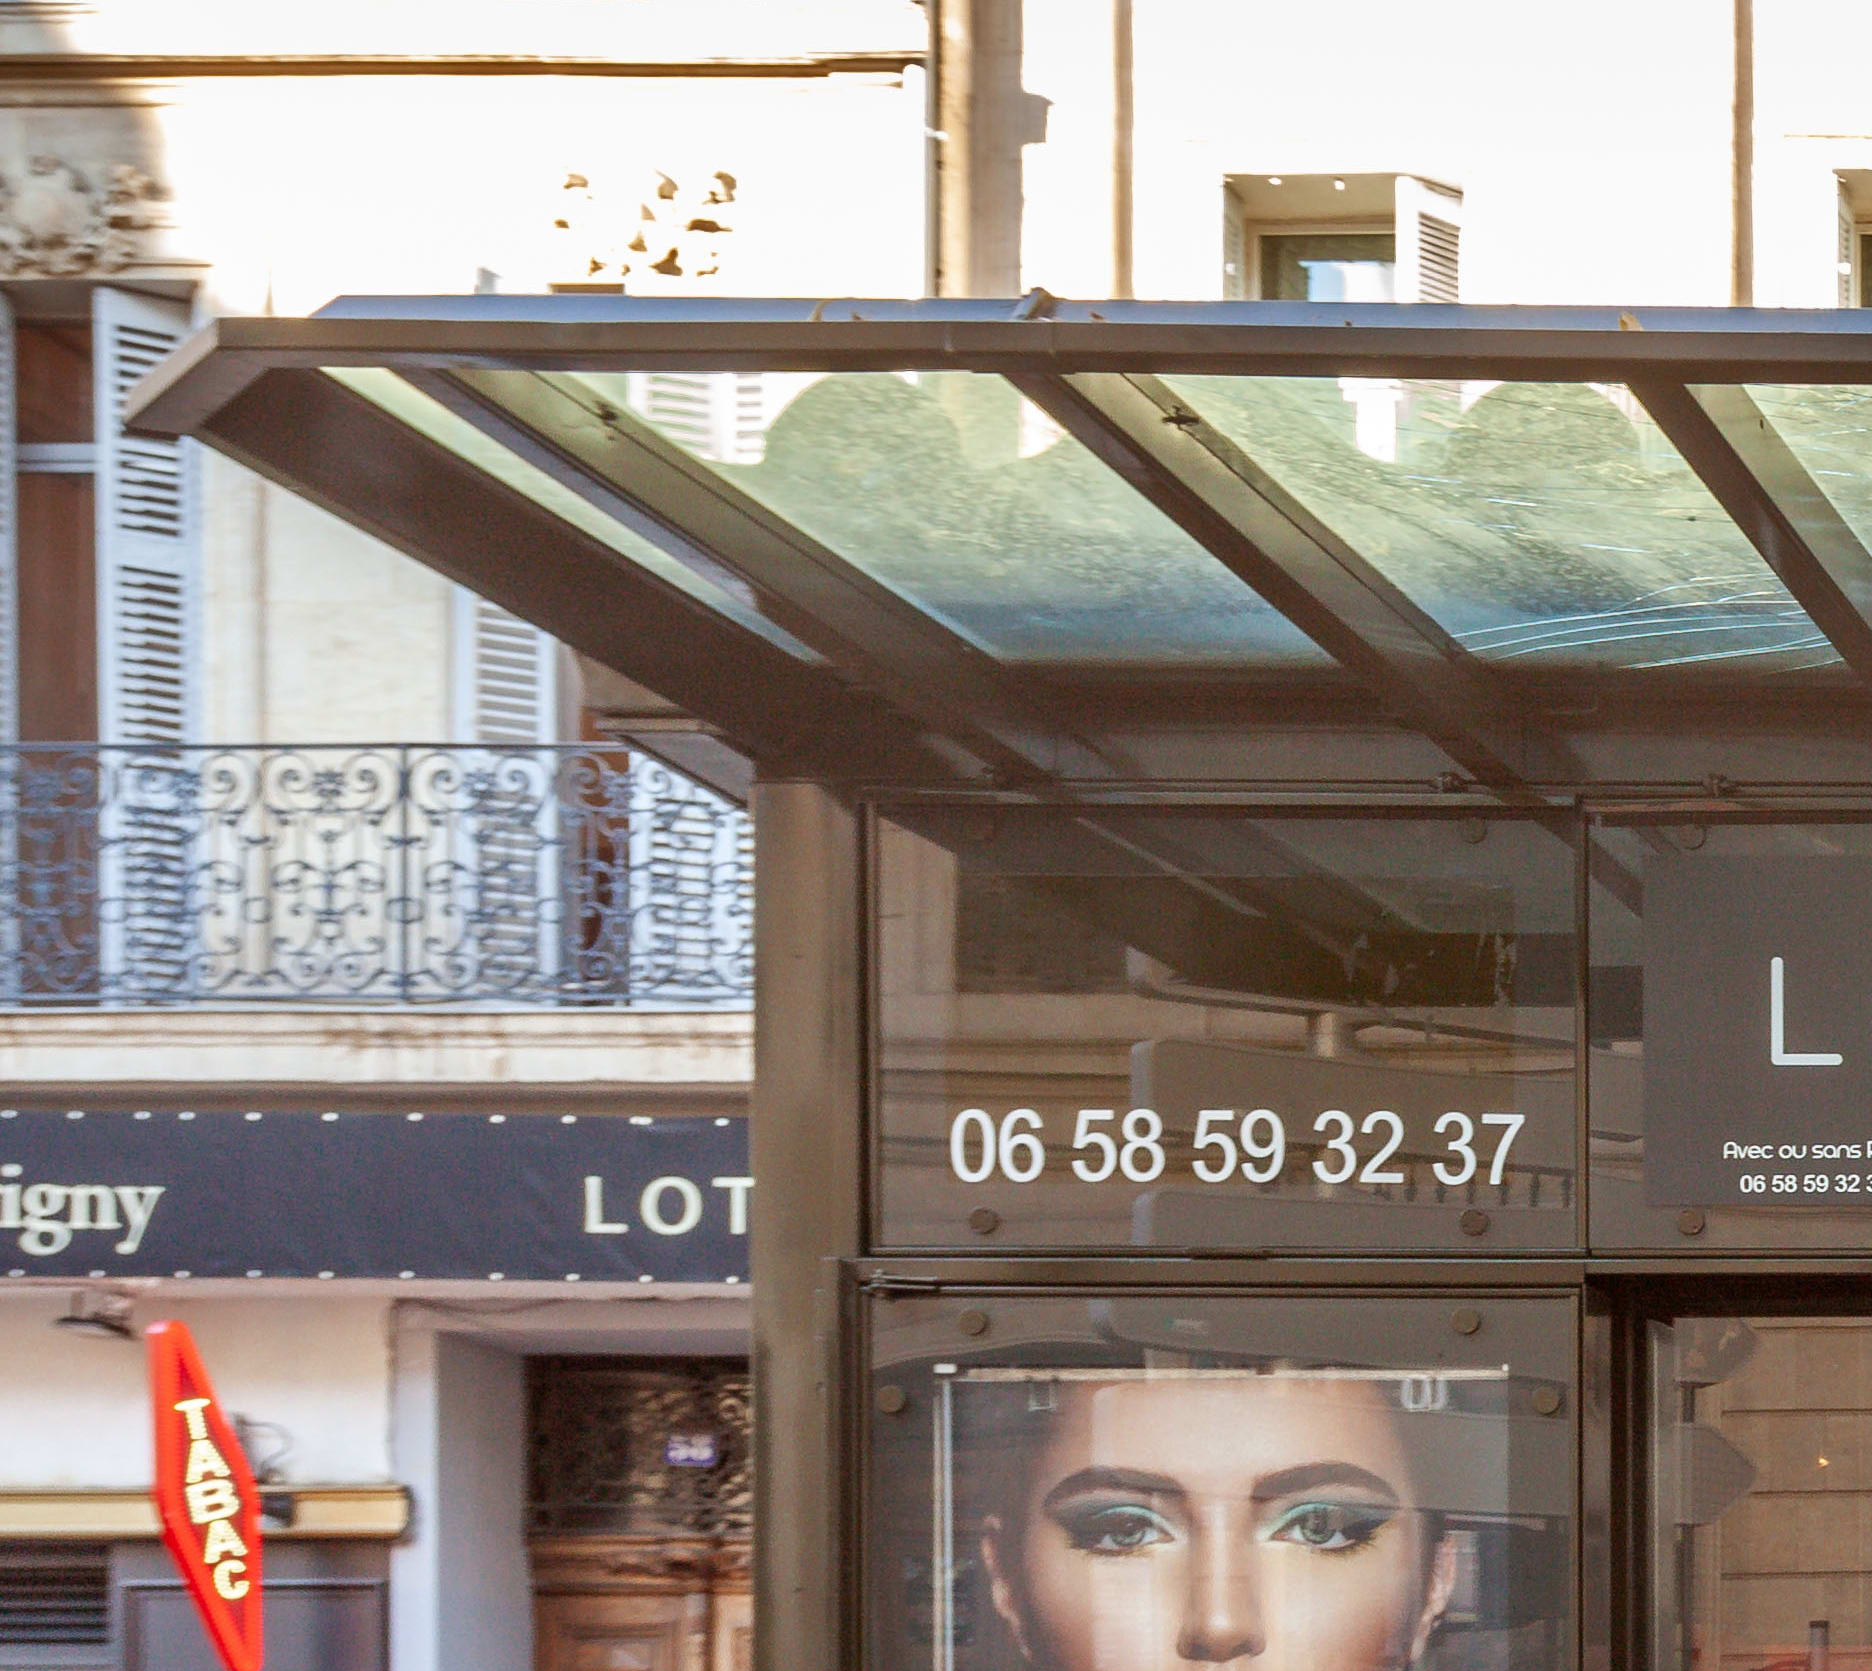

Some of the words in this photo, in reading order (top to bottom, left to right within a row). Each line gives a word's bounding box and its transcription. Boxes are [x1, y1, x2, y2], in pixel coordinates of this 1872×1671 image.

[950, 1108, 1045, 1183] 06
[1071, 1108, 1165, 1183] 58
[1192, 1109, 1285, 1183] 59
[1312, 1110, 1404, 1184] 32
[1432, 1111, 1525, 1186] 37
[1723, 1141, 1774, 1159] Avec
[1778, 1144, 1807, 1159] ou
[1811, 1144, 1862, 1159] sans
[584, 1175, 756, 1236] LOT
[1739, 1174, 1766, 1193] 06
[1771, 1174, 1798, 1193] 58
[1803, 1174, 1829, 1193] 59
[1834, 1174, 1861, 1193] 32
[173, 1398, 250, 1600] TABAC
